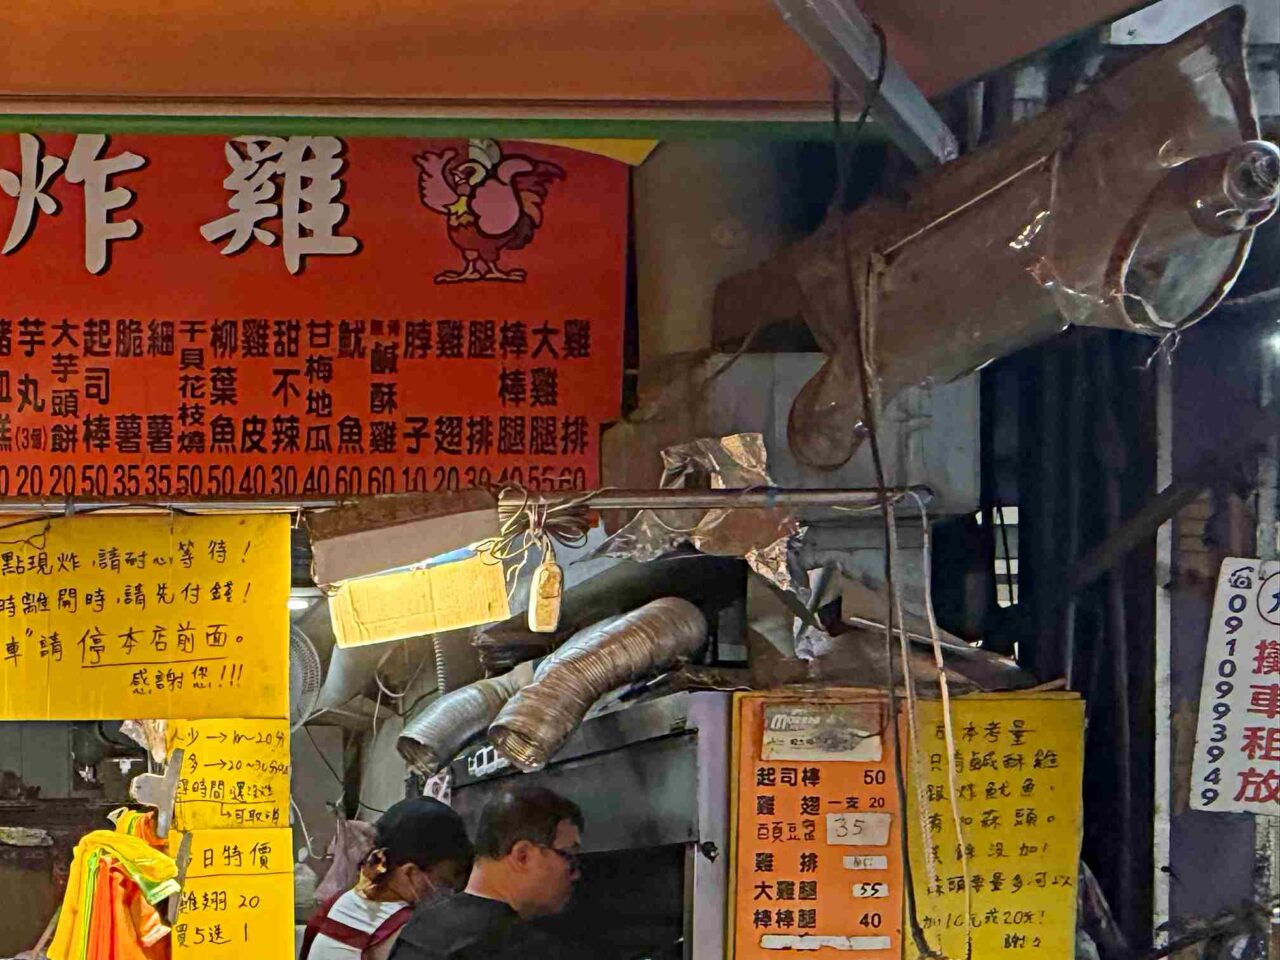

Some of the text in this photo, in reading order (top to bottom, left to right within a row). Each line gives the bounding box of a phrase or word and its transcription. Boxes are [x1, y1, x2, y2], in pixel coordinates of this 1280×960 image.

[50, 319, 80, 495] 大芋頭餅 20
[81, 318, 111, 495] 起司棒 50
[113, 319, 144, 495] 脆薯 35
[145, 319, 175, 495] 細薯 35
[208, 319, 238, 495] 柳葉魚 50
[239, 319, 270, 495] 雞皮 40
[271, 319, 301, 495] 甜不辣 30
[303, 320, 334, 495] 甘梅地瓜 40
[336, 320, 366, 492] 魷魚 60
[434, 320, 464, 455] 雞翅
[466, 320, 496, 455] 腿排
[497, 320, 527, 455] 棒棒腿
[528, 320, 559, 455] 大雞腿
[560, 319, 591, 455] 雞排
[16, 464, 43, 495] 20
[177, 465, 203, 495] 50
[370, 465, 394, 492] 60
[402, 465, 426, 492] 10
[1201, 594, 1247, 806] 0910993949
[756, 767, 886, 787] 起司棒 50
[756, 795, 820, 816] 雞翅
[869, 797, 885, 809] 20
[834, 817, 866, 838] 35
[187, 842, 272, 869] 日特價
[238, 895, 260, 910] 20
[753, 881, 883, 901] 大雞腿 55
[753, 909, 882, 929] 棒棒腿 40
[754, 853, 818, 872] 雞排
